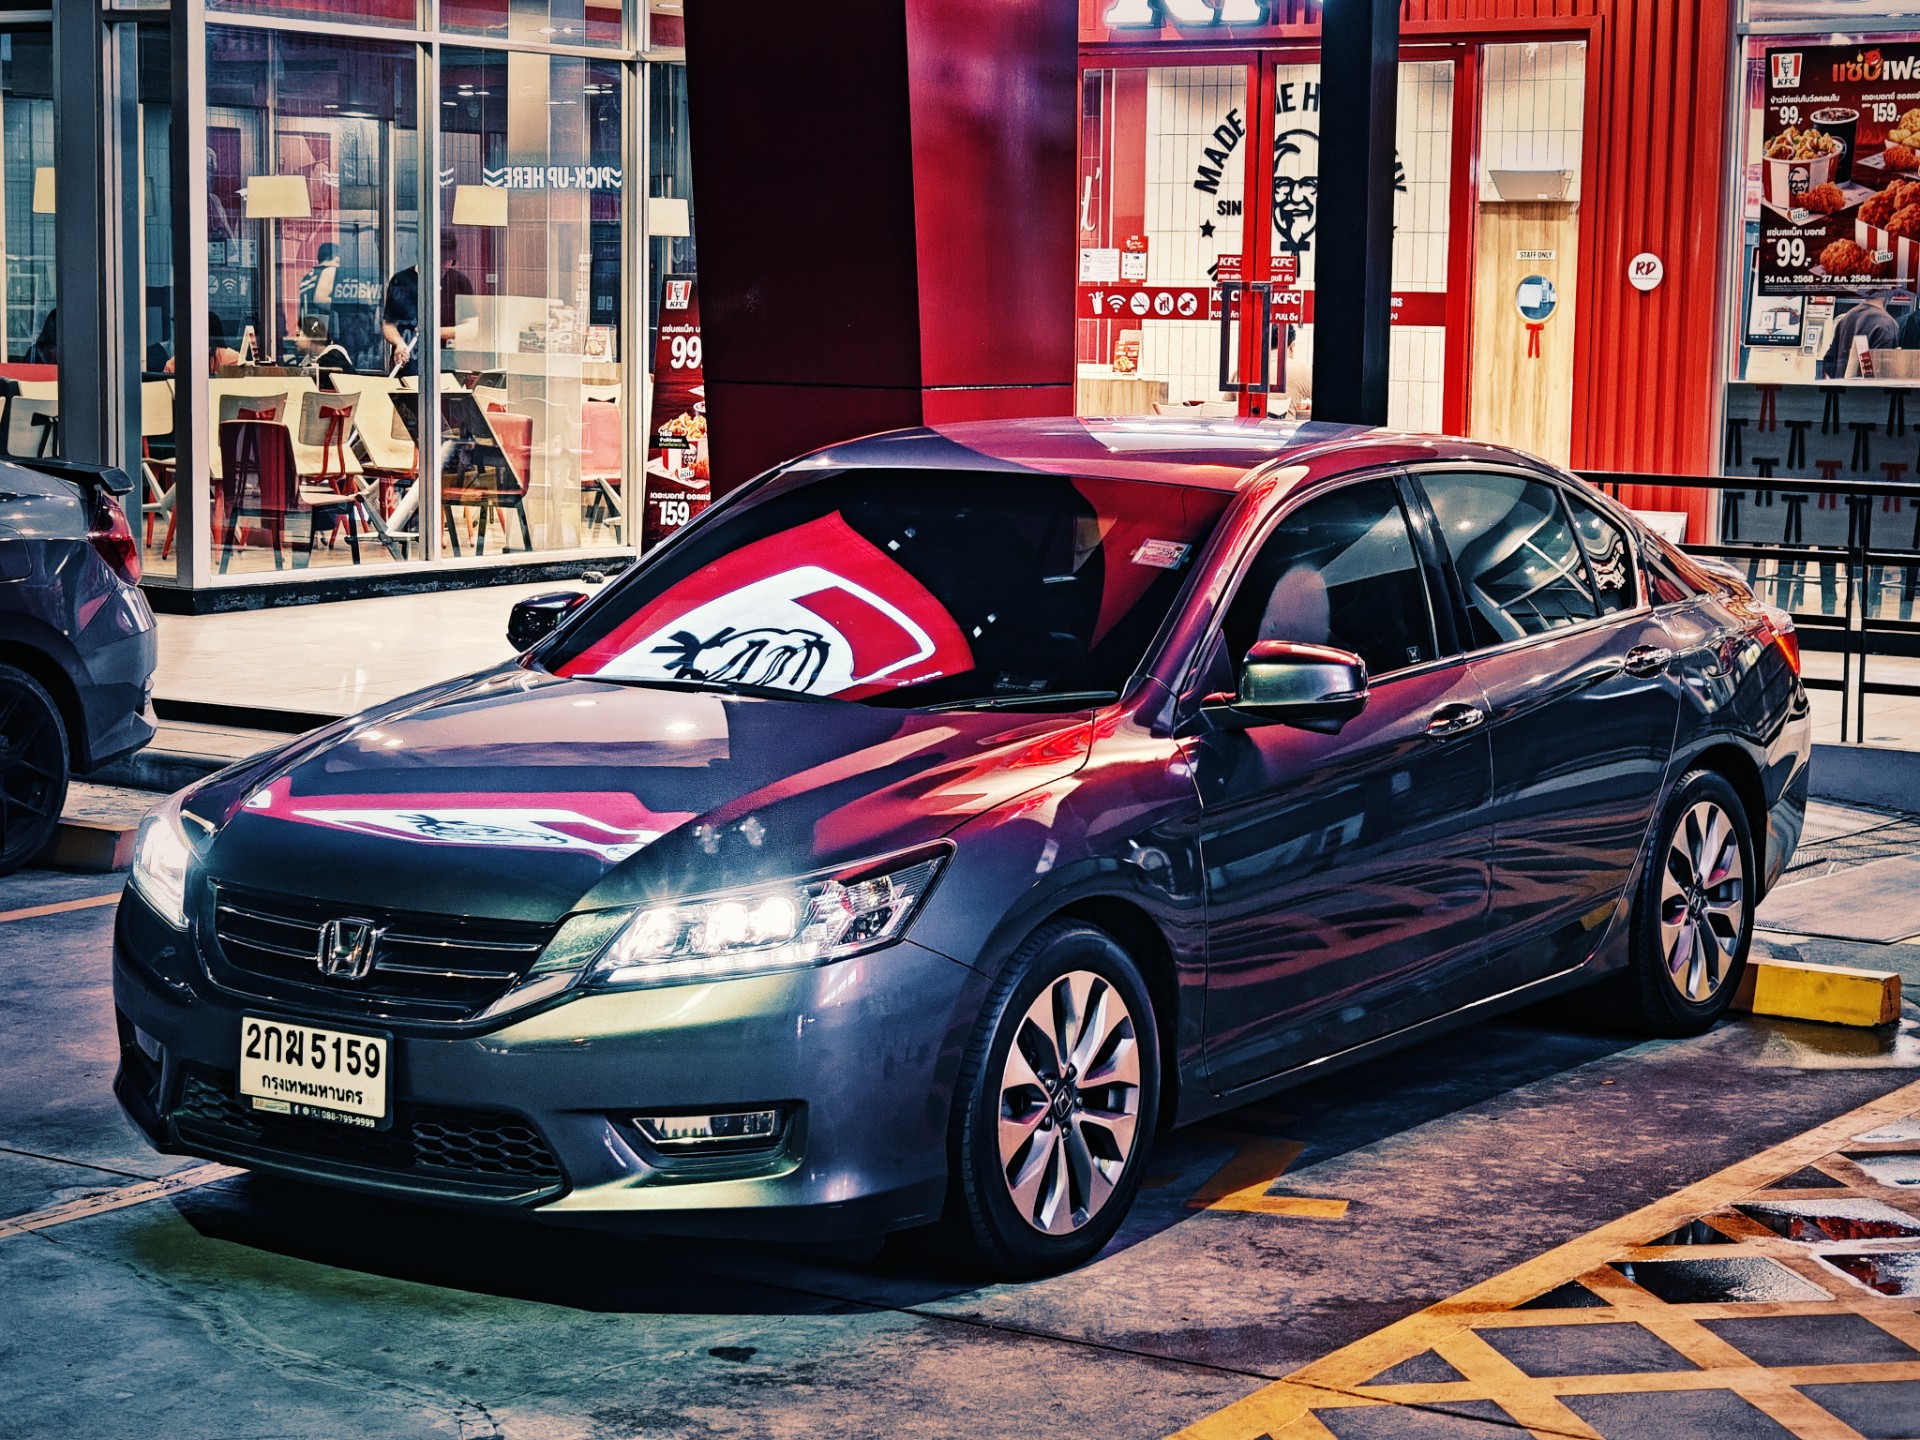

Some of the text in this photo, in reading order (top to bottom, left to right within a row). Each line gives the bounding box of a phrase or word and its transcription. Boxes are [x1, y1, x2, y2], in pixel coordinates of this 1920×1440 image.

[1194, 108, 1245, 195] MADE
[1217, 200, 1242, 216] SIN
[1520, 251, 1552, 259] STAFF ONLY
[1219, 257, 1241, 266] KFC
[1270, 258, 1294, 267] KFC
[1635, 261, 1656, 276] RD
[1764, 275, 1775, 283] 24
[1793, 275, 1814, 283] 2568
[1821, 275, 1832, 283] 27
[1850, 274, 1872, 283] 2568
[1212, 290, 1239, 302] KC
[1271, 292, 1300, 305] KFC
[1391, 297, 1403, 307] RS
[1211, 310, 1222, 318] PUS
[1275, 312, 1288, 321] PULL
[311, 1033, 380, 1079] 5159
[262, 1074, 363, 1105] กรุงเทพมหานคร
[321, 1110, 376, 1128] 088-799-9999
